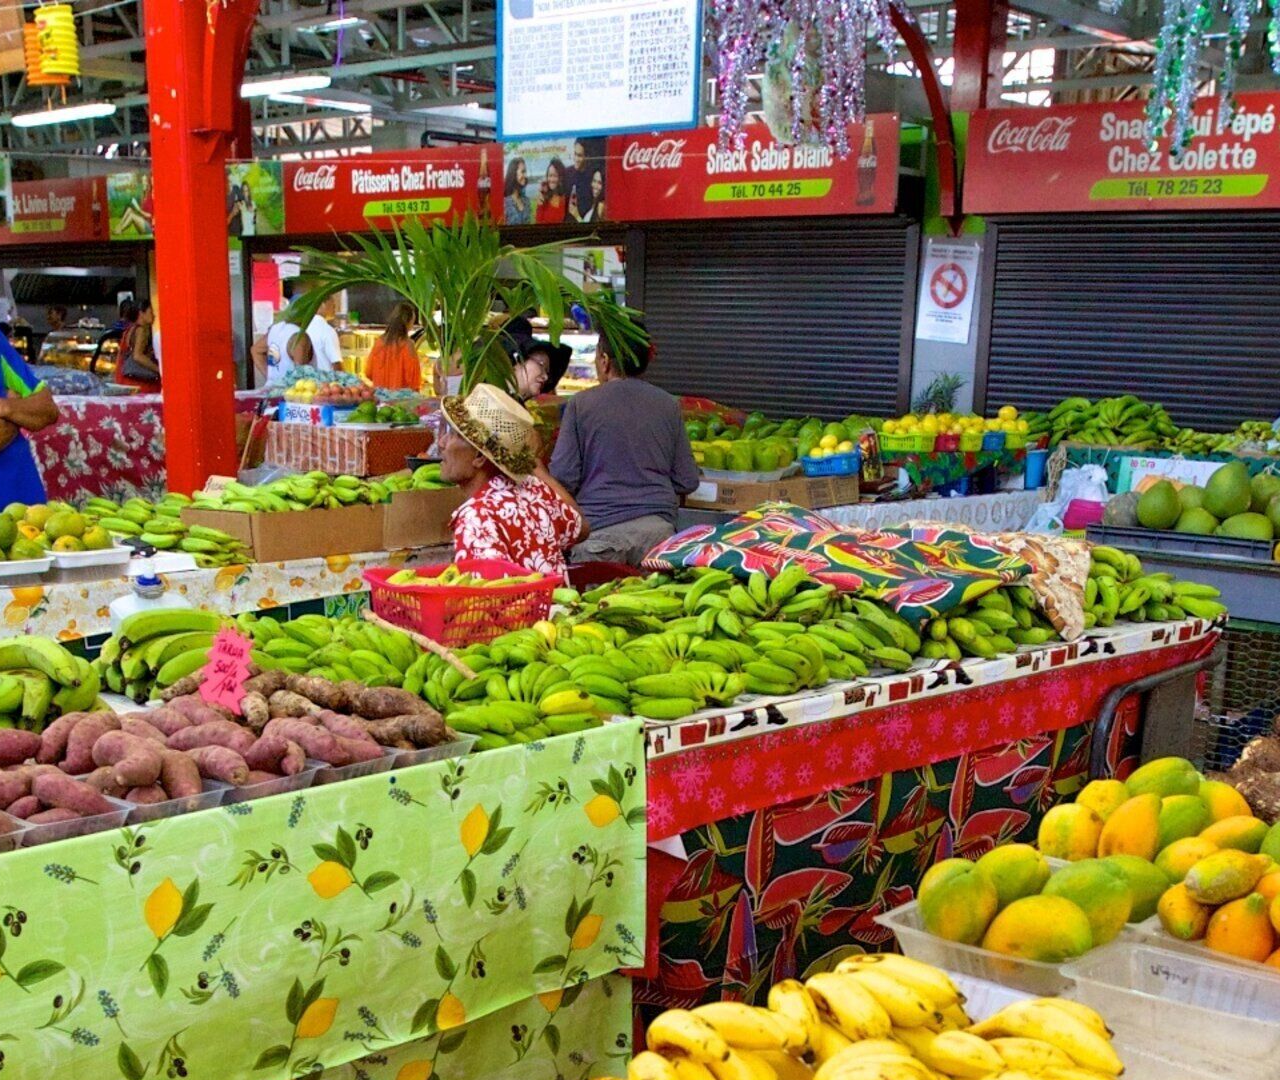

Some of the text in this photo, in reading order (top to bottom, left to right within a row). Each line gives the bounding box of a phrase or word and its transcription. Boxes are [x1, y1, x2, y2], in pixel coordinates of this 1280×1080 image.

[987, 116, 1077, 154] Coca-Cola
[622, 138, 688, 171] Coca-Cola
[706, 142, 748, 175] Snack
[751, 140, 789, 171] Sable
[1108, 145, 1161, 174] Chez
[294, 164, 338, 192] Coca-Cola
[351, 167, 400, 194] Pâtisserie
[401, 165, 425, 191] Chez
[425, 162, 465, 190] Francis
[731, 181, 802, 198] Tél. 70 44 25
[1128, 178, 1223, 197] Tél. 78 25 23
[396, 201, 407, 212] 53
[407, 201, 418, 212] 43
[419, 200, 431, 211] 73
